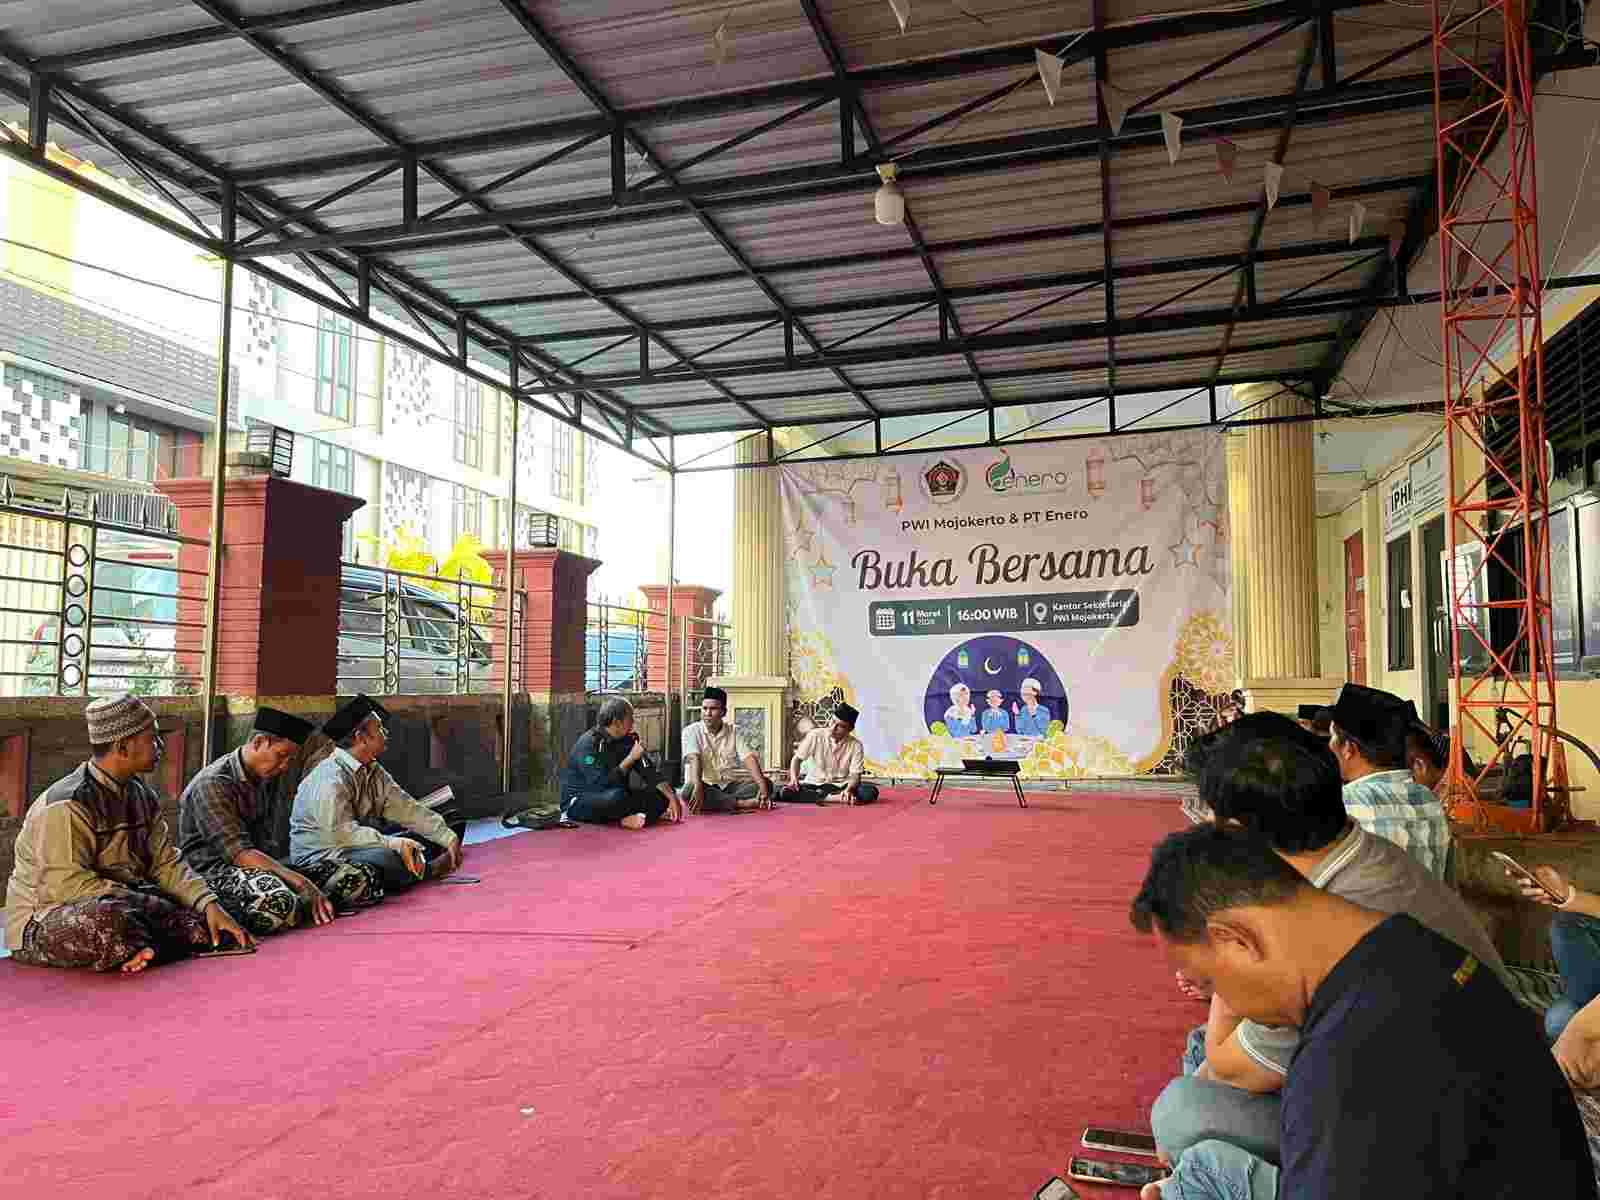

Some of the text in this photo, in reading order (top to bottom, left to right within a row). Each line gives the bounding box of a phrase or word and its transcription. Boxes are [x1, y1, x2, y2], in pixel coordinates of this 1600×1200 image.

[902, 508, 1089, 530] PWI Mojokerto & PT Enero
[851, 543, 1154, 590] Buka Bersama
[901, 610, 914, 625] 11
[957, 607, 1018, 621] 16:00 WIB
